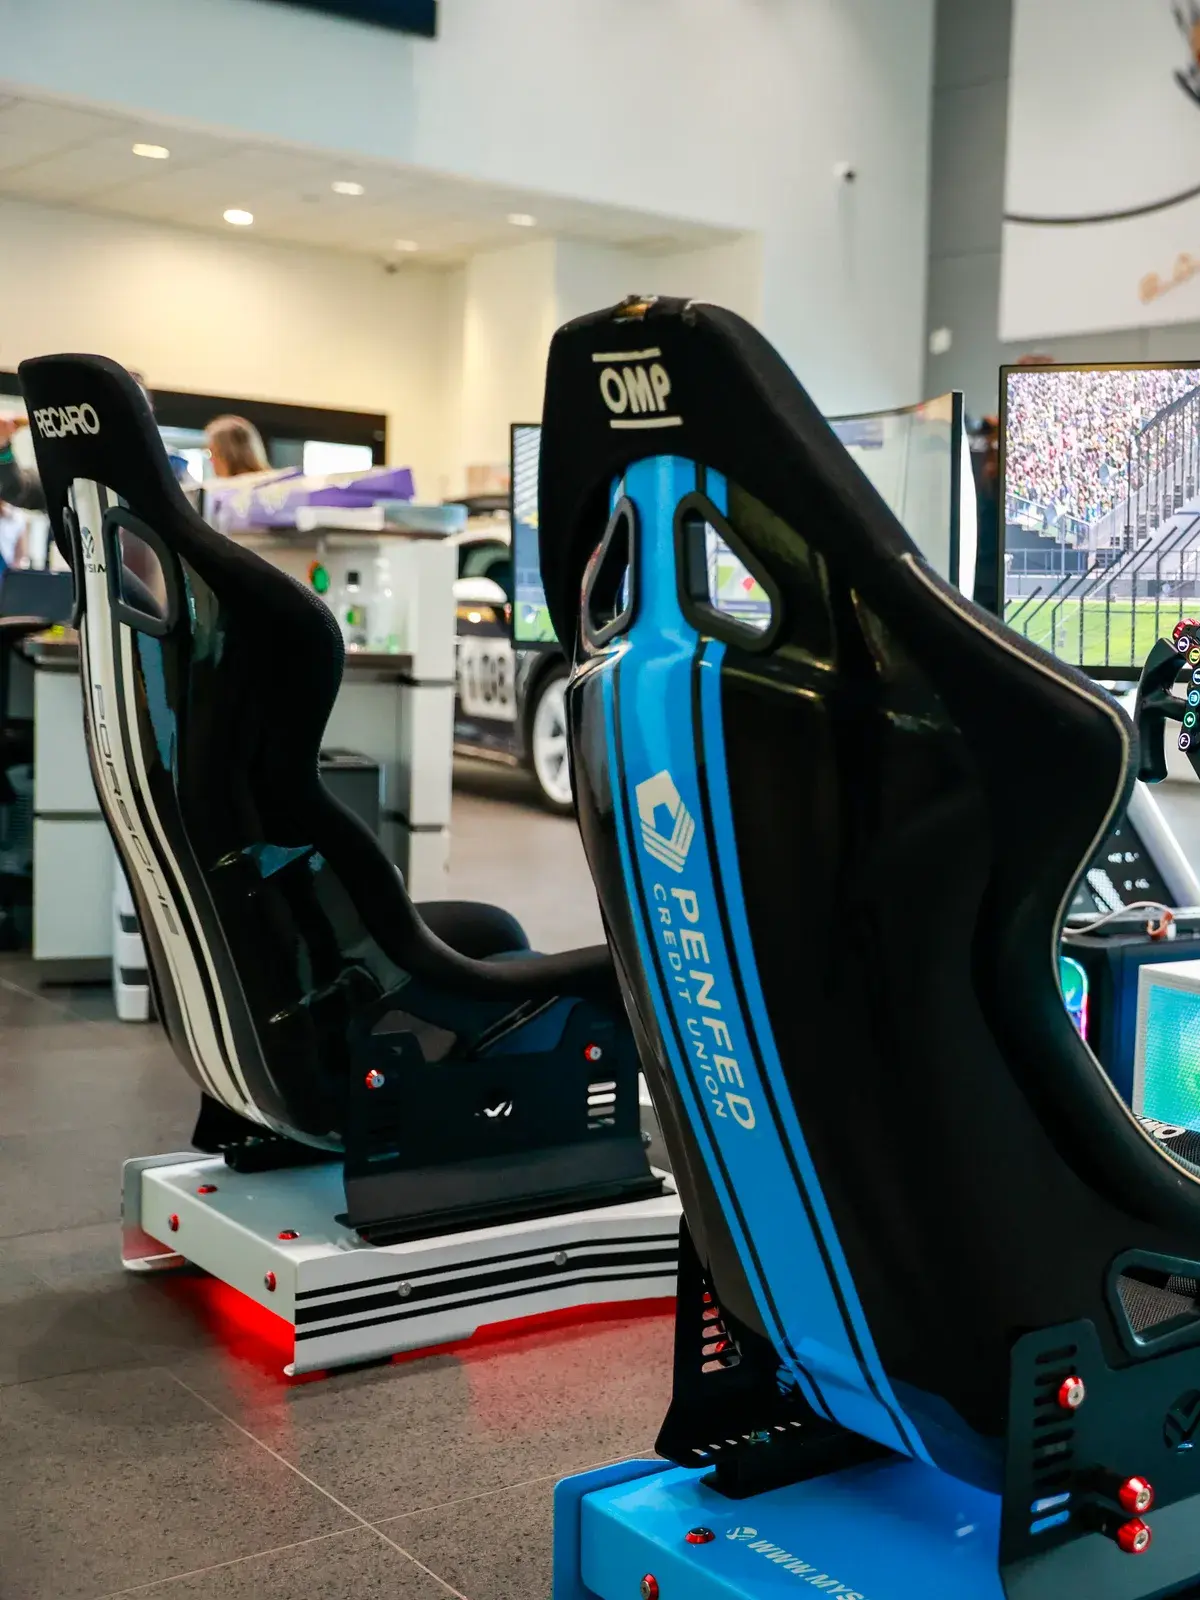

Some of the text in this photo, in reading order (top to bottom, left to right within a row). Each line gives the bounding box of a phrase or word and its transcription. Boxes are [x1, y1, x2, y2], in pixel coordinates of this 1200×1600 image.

[32, 402, 101, 439] RECARO
[599, 363, 671, 414] OMP
[94, 683, 180, 936] PORSCHE
[653, 881, 729, 1120] CREDIT UNION
[671, 887, 756, 1131] PENFED
